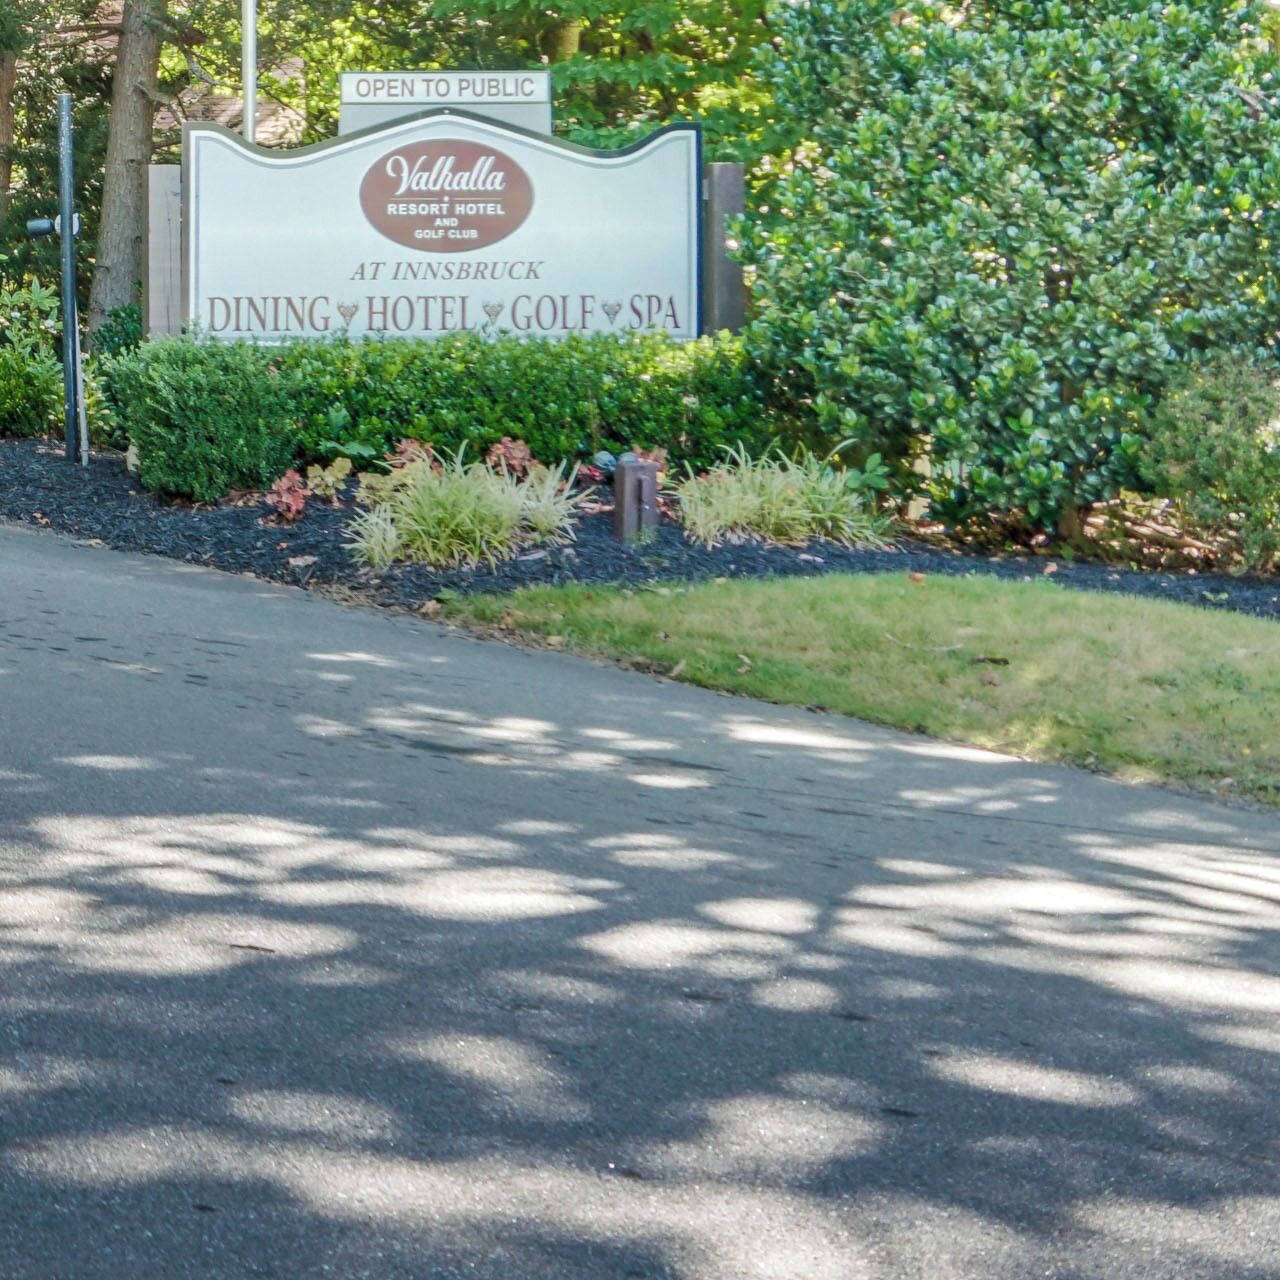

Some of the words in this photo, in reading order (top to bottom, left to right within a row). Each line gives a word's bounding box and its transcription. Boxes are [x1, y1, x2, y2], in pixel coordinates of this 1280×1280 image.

[355, 77, 415, 98] OPEN
[421, 78, 451, 98] TO
[458, 77, 535, 98] PUBLIC
[385, 154, 507, 196] Valhalla
[386, 203, 450, 216] RESORT
[455, 203, 505, 216] HOTEL
[434, 217, 459, 227] AND
[414, 229, 445, 239] GOLF
[448, 228, 479, 239] CLUB
[349, 261, 386, 281] AT
[391, 260, 545, 281] INNSBRUCK
[207, 295, 331, 332] DINING
[366, 294, 476, 332] HOTEL
[511, 293, 595, 331] GOLF
[628, 293, 682, 330] SPA
